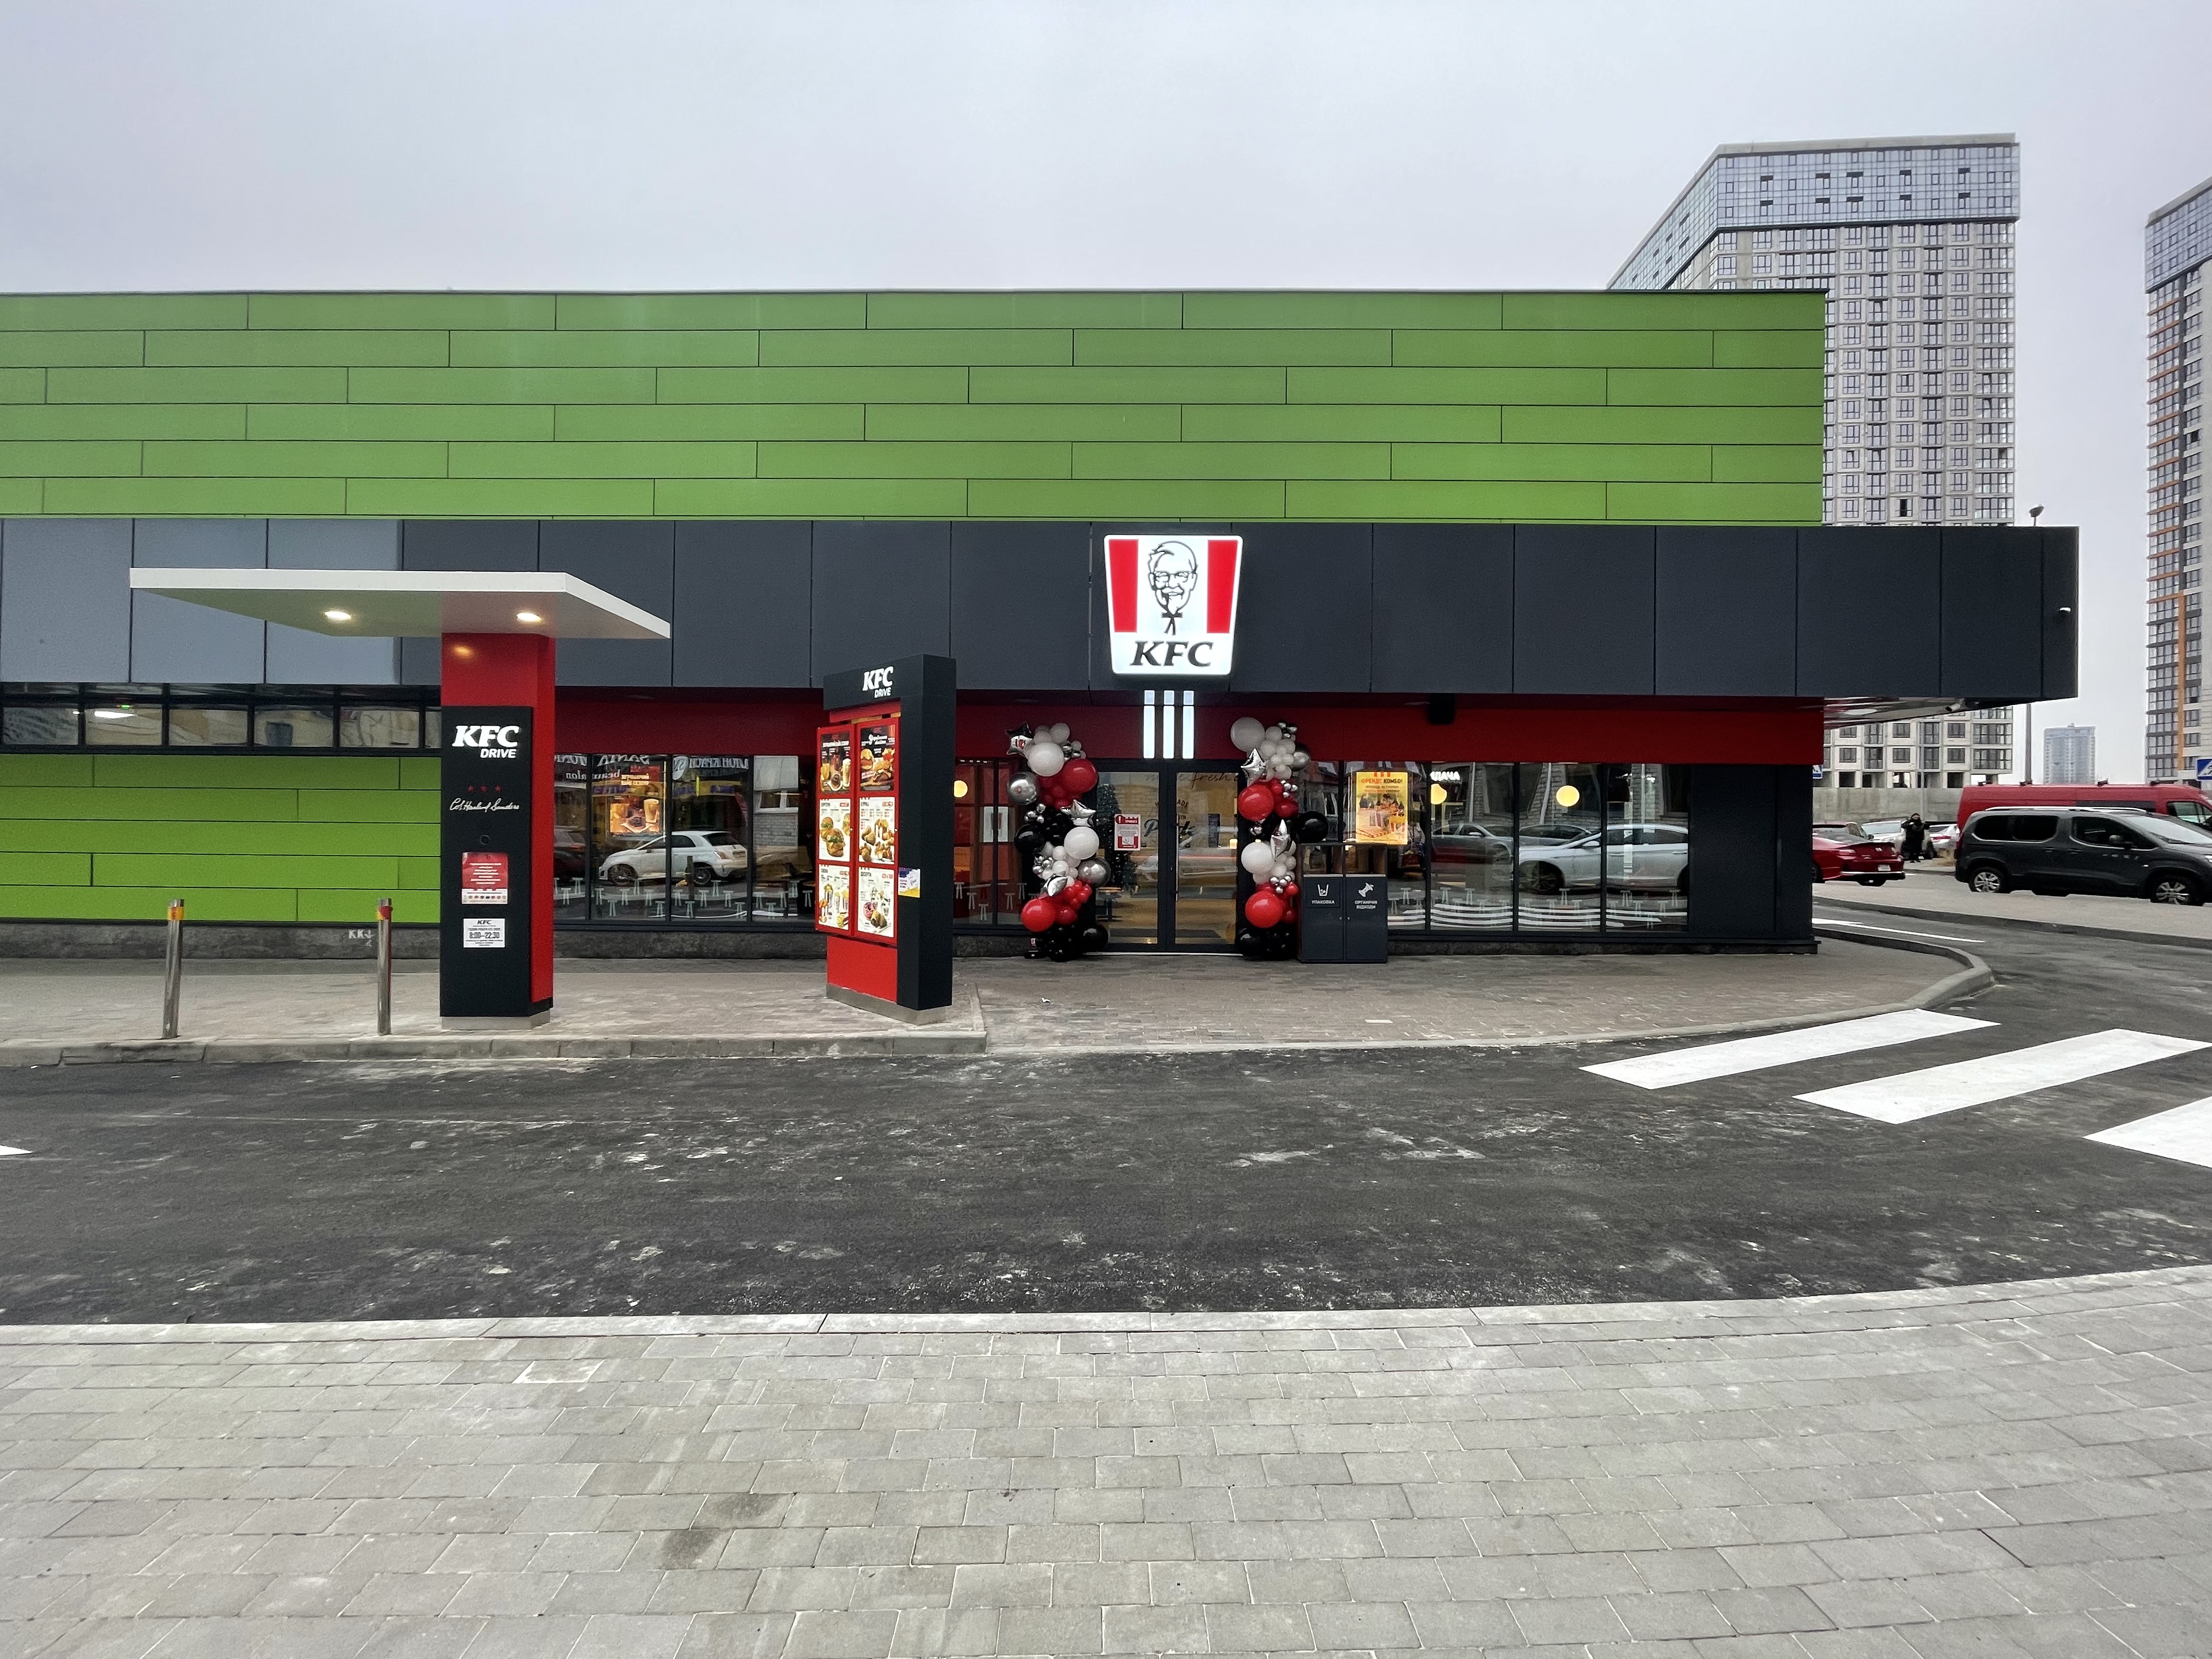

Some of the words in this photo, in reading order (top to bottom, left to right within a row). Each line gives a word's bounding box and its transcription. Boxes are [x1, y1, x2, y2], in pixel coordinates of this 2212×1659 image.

[1130, 640, 1214, 667] KFC
[862, 665, 894, 692] KFC
[874, 687, 891, 698] DRIVE
[452, 725, 521, 748] KFC
[480, 748, 517, 758] DRIVE
